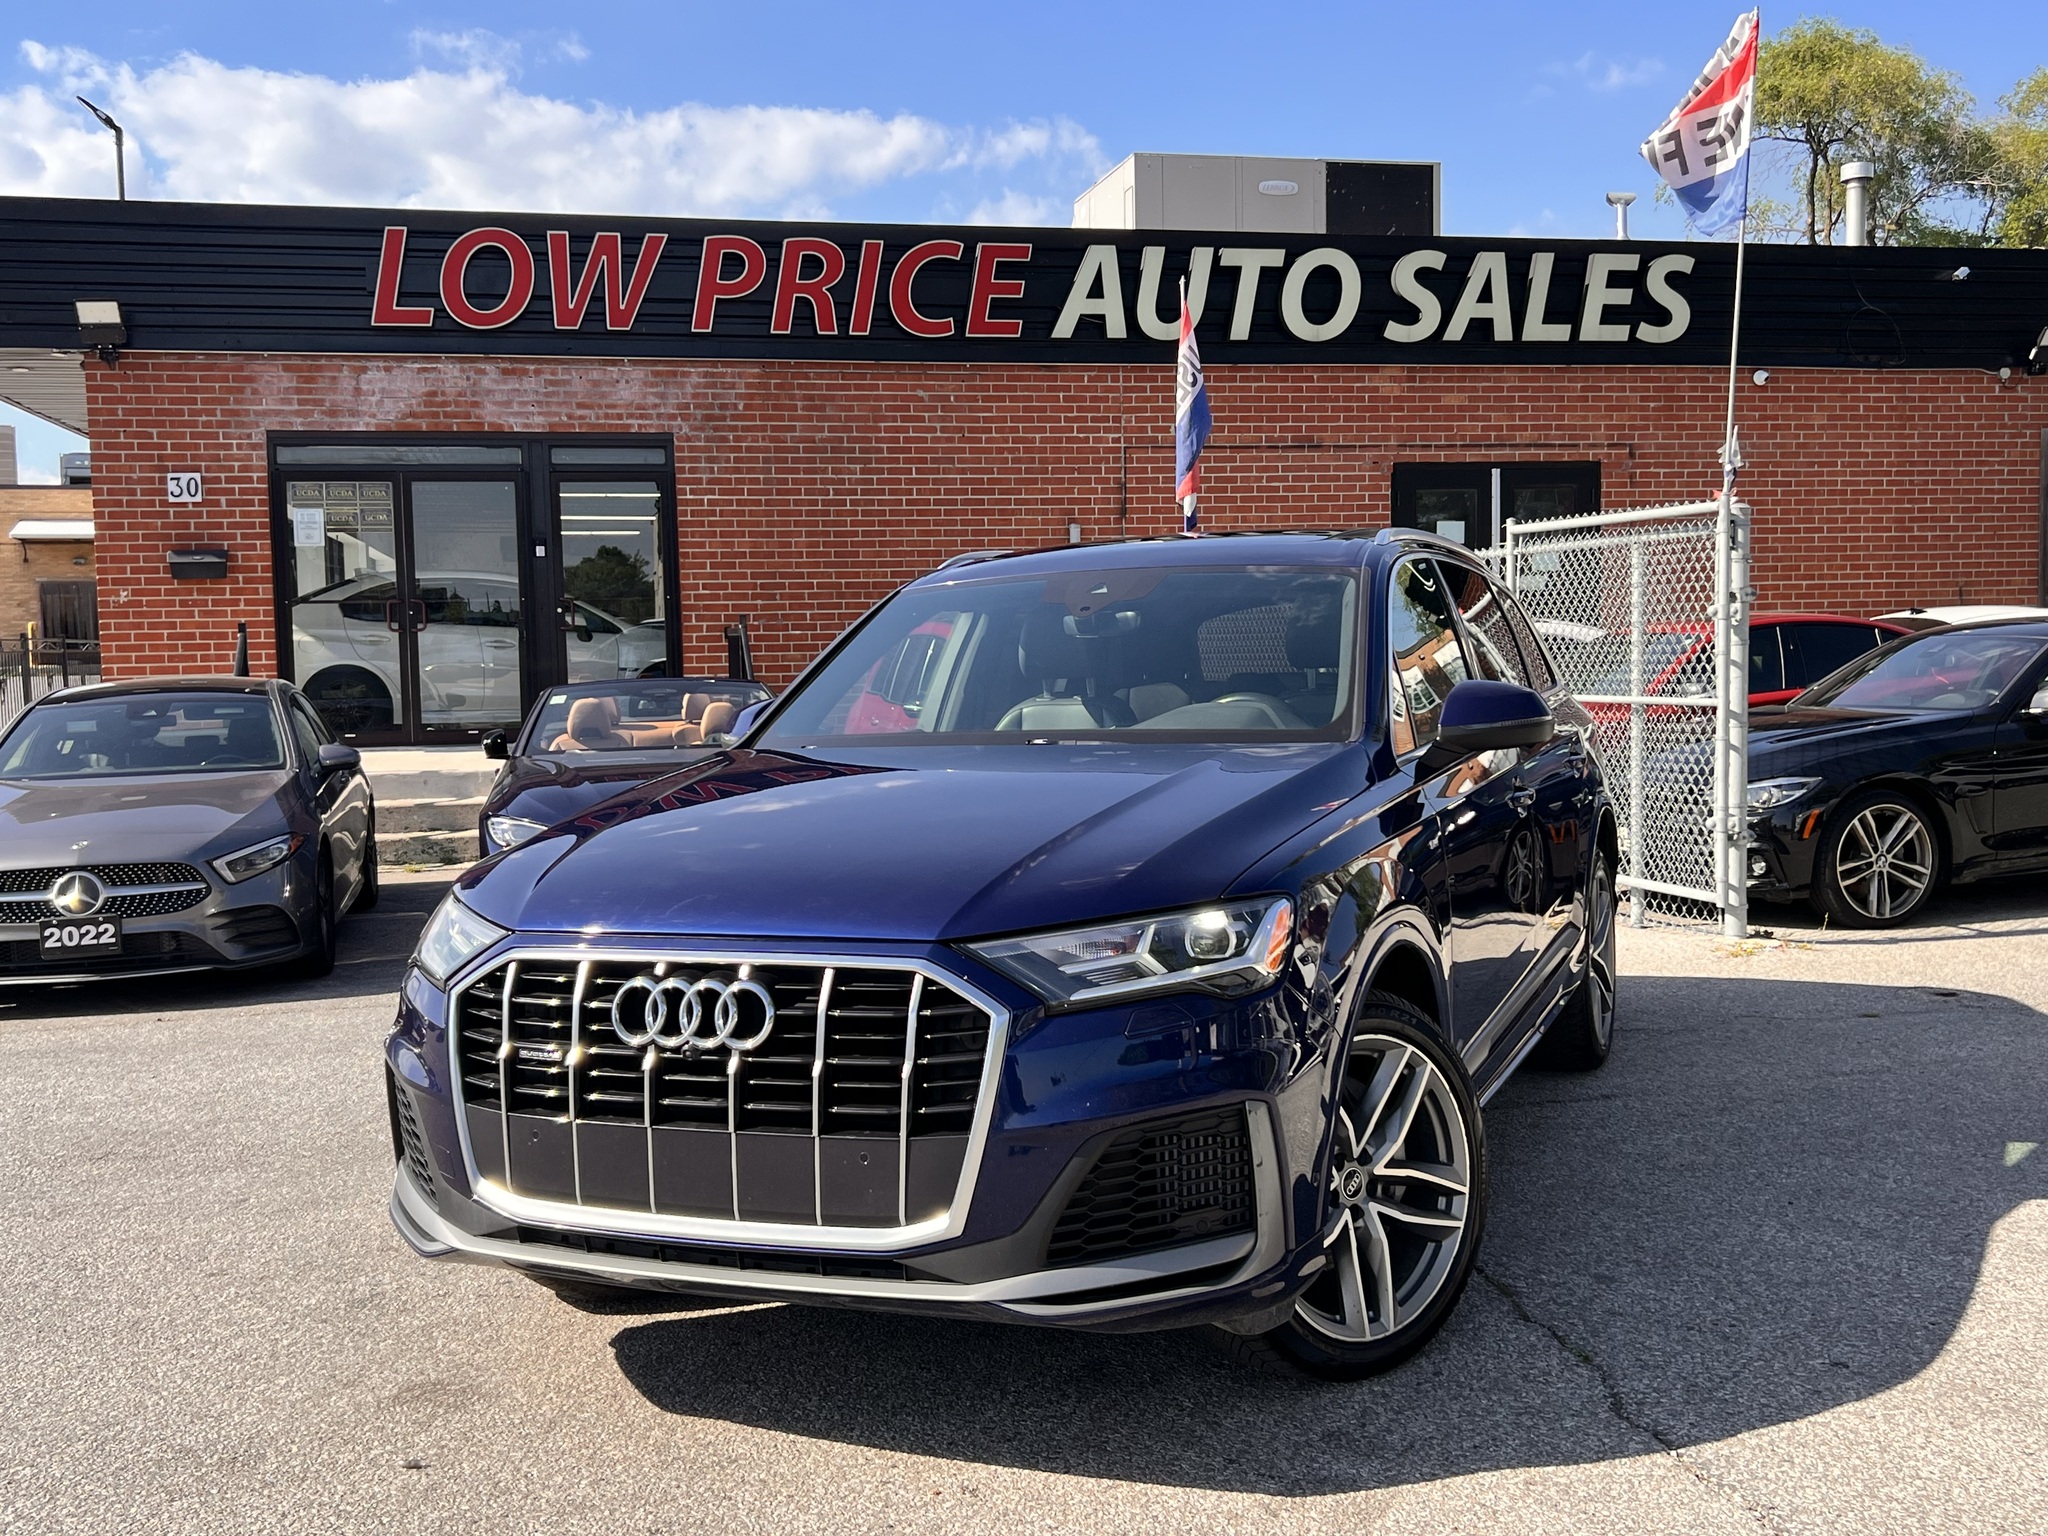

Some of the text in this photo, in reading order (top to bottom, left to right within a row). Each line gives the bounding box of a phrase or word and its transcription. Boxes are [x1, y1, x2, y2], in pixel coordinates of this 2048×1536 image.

[370, 226, 1696, 344] LOW PRICE AUTO SALES
[170, 477, 199, 498] 30
[329, 489, 353, 497] UCDA
[43, 923, 116, 949] 2022
